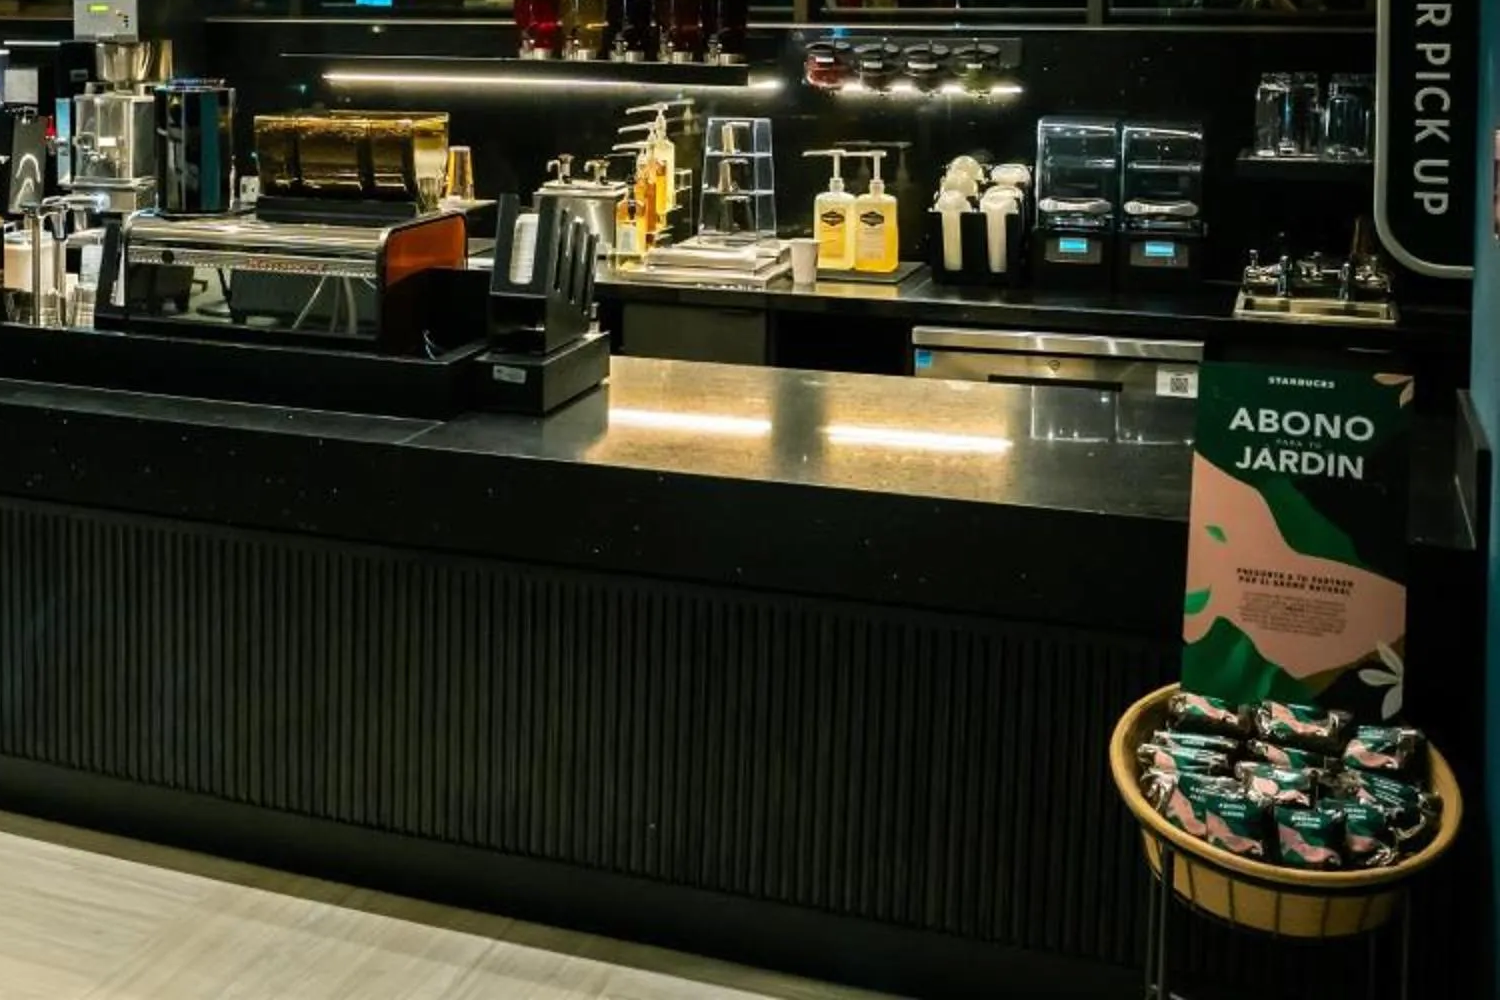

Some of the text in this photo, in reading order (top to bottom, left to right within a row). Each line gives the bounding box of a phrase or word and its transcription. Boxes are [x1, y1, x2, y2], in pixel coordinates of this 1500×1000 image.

[1414, 43, 1451, 143] PICK
[1413, 159, 1450, 215] UP
[1267, 376, 1335, 389] STARBUCKS
[1228, 407, 1375, 442] ABONO
[1235, 445, 1364, 480] JARDIN
